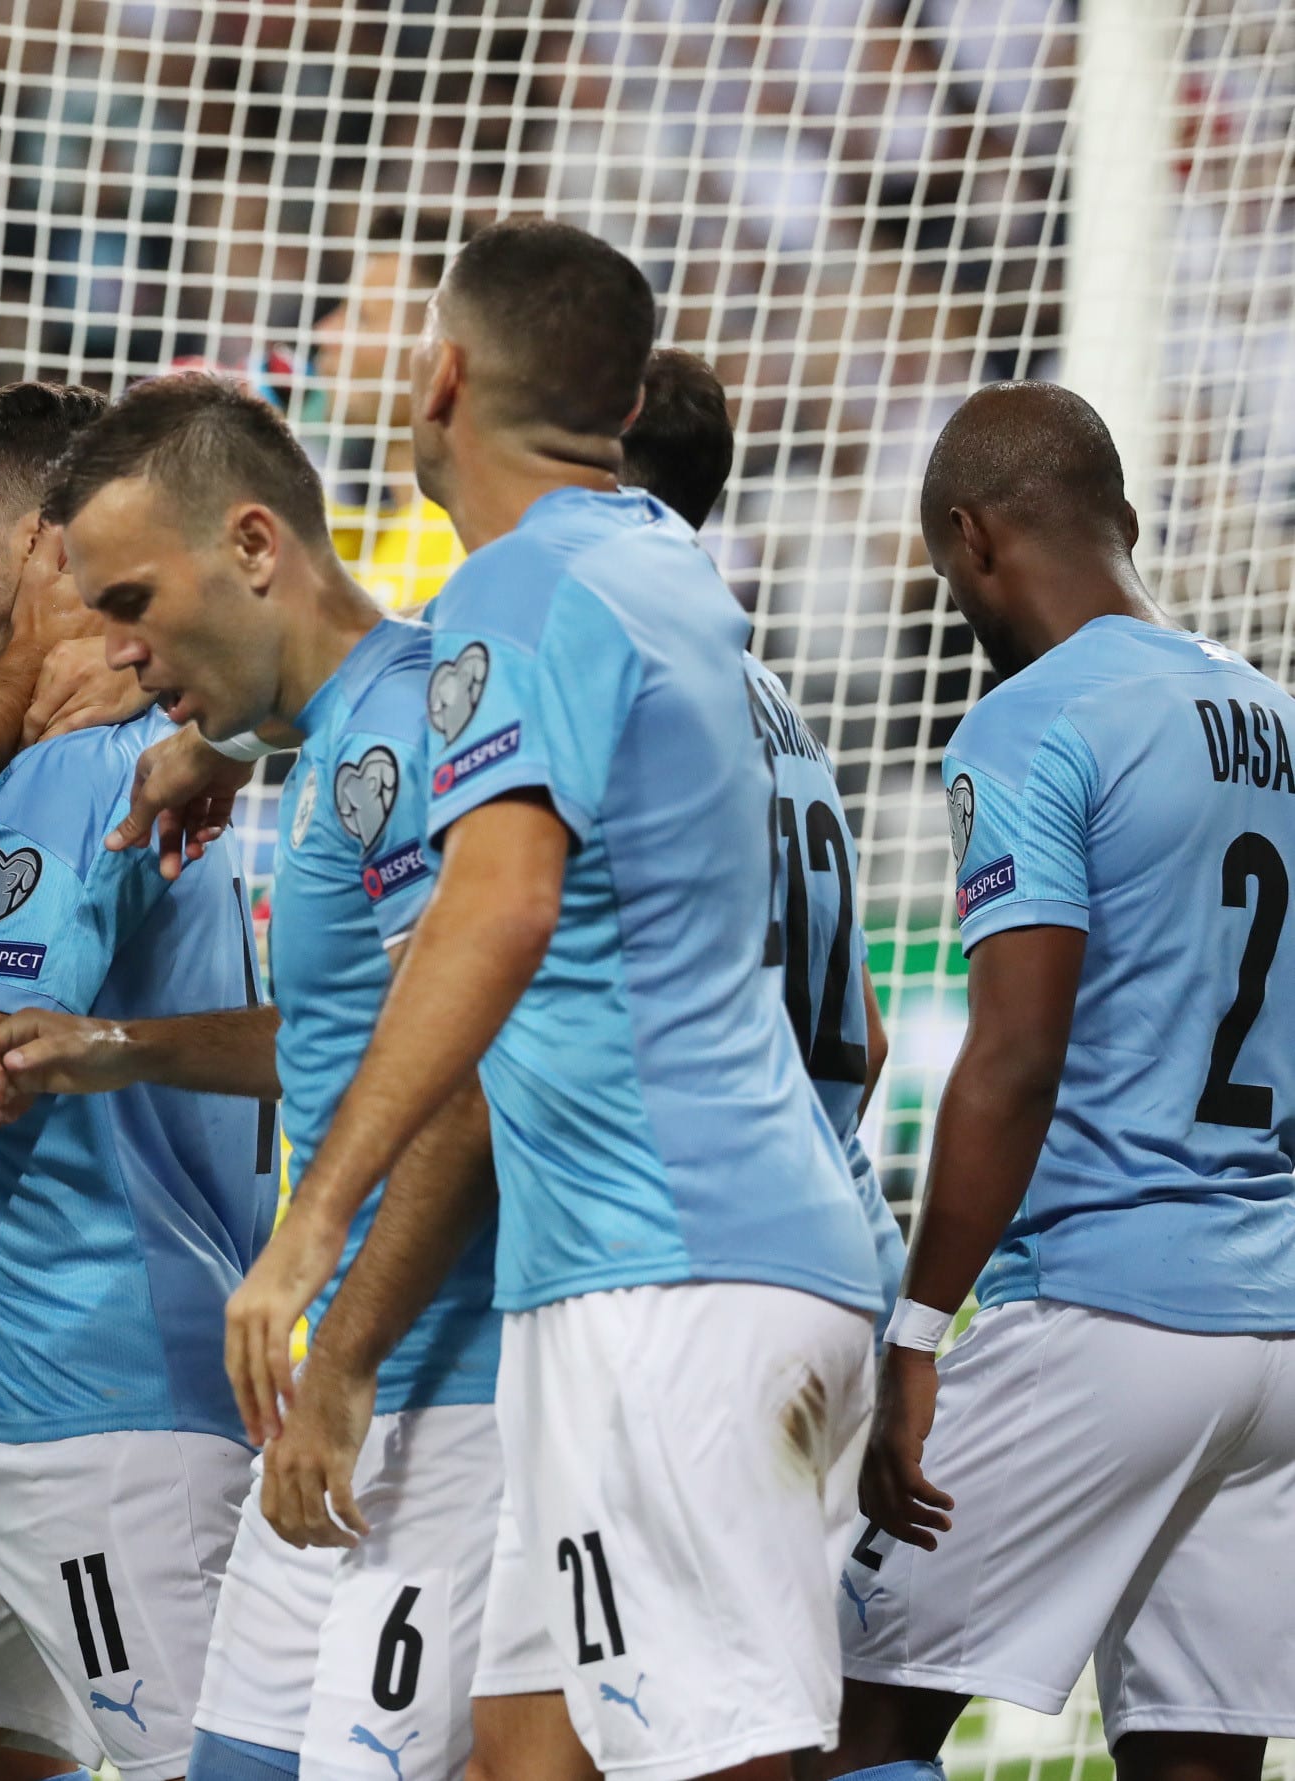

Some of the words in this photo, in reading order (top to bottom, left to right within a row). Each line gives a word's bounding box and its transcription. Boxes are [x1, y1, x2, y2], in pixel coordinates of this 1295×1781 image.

[455, 729, 519, 776] RESPECT
[379, 848, 426, 883] RESPEC
[967, 865, 1013, 904] RESPECT
[777, 798, 866, 1085] 12
[1193, 831, 1289, 1130] 2
[61, 1552, 130, 1680] 11
[372, 1586, 423, 1712] 6
[558, 1532, 625, 1665] 21
